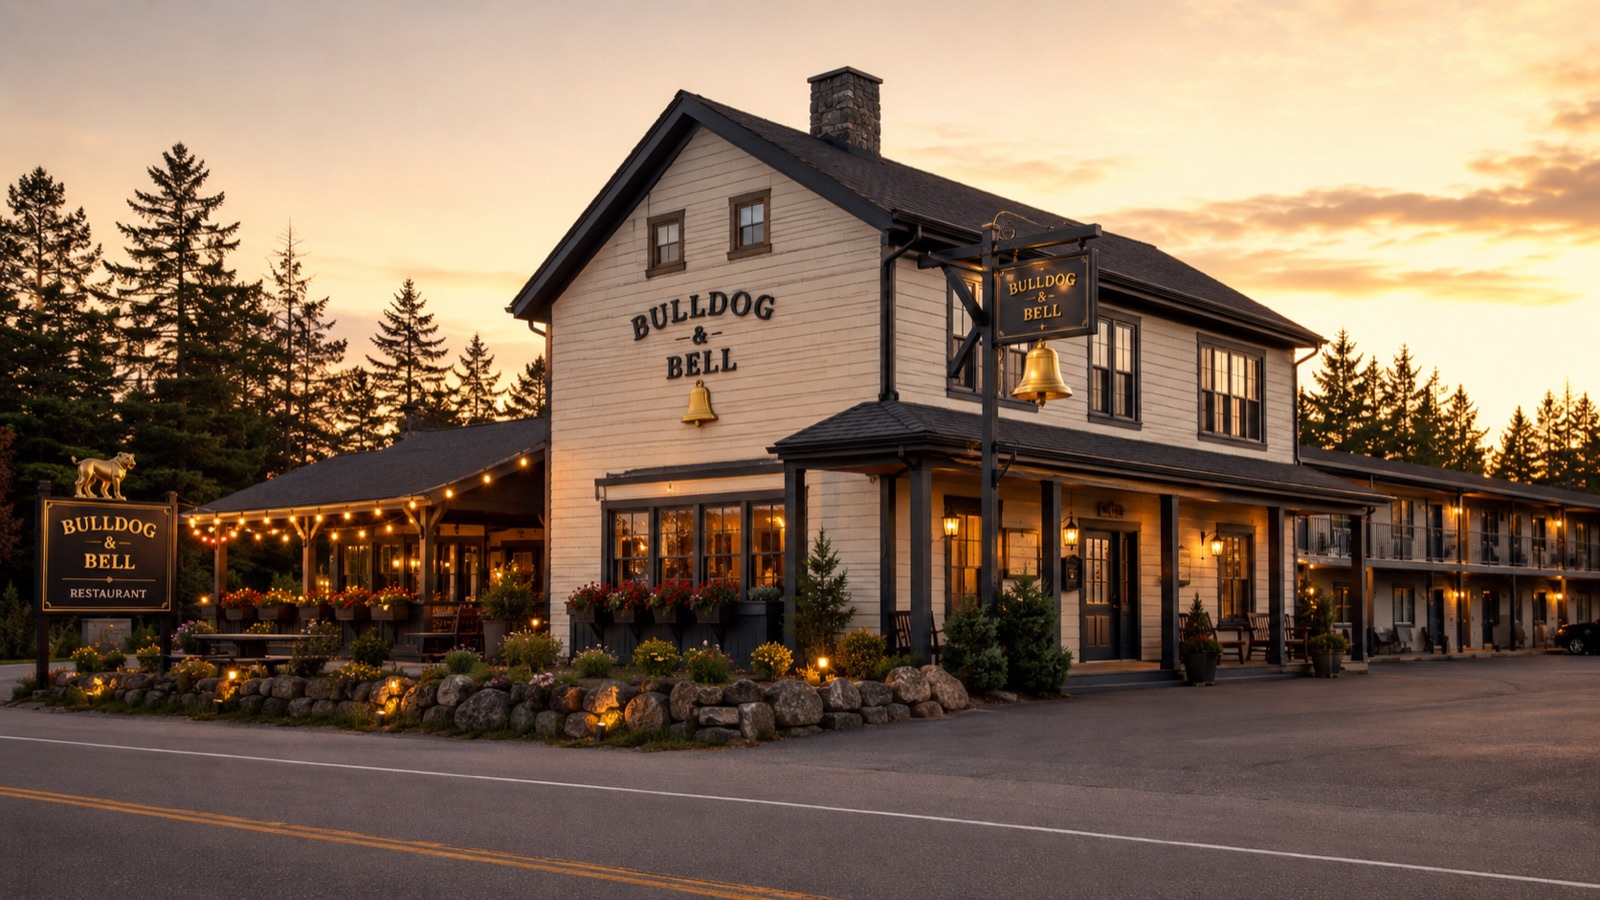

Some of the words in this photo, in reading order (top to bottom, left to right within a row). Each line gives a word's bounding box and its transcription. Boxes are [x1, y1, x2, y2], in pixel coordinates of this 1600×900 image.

[1009, 272, 1076, 296] BULLDOG
[1037, 291, 1047, 303] &
[630, 290, 775, 341] BULLDOG
[1023, 303, 1062, 321] BELL
[692, 325, 708, 345] &
[666, 347, 737, 380] BELL
[61, 515, 157, 539] BULLDOG
[104, 535, 116, 550] &
[84, 553, 136, 570] BELL
[70, 588, 147, 599] RESTAURANT
